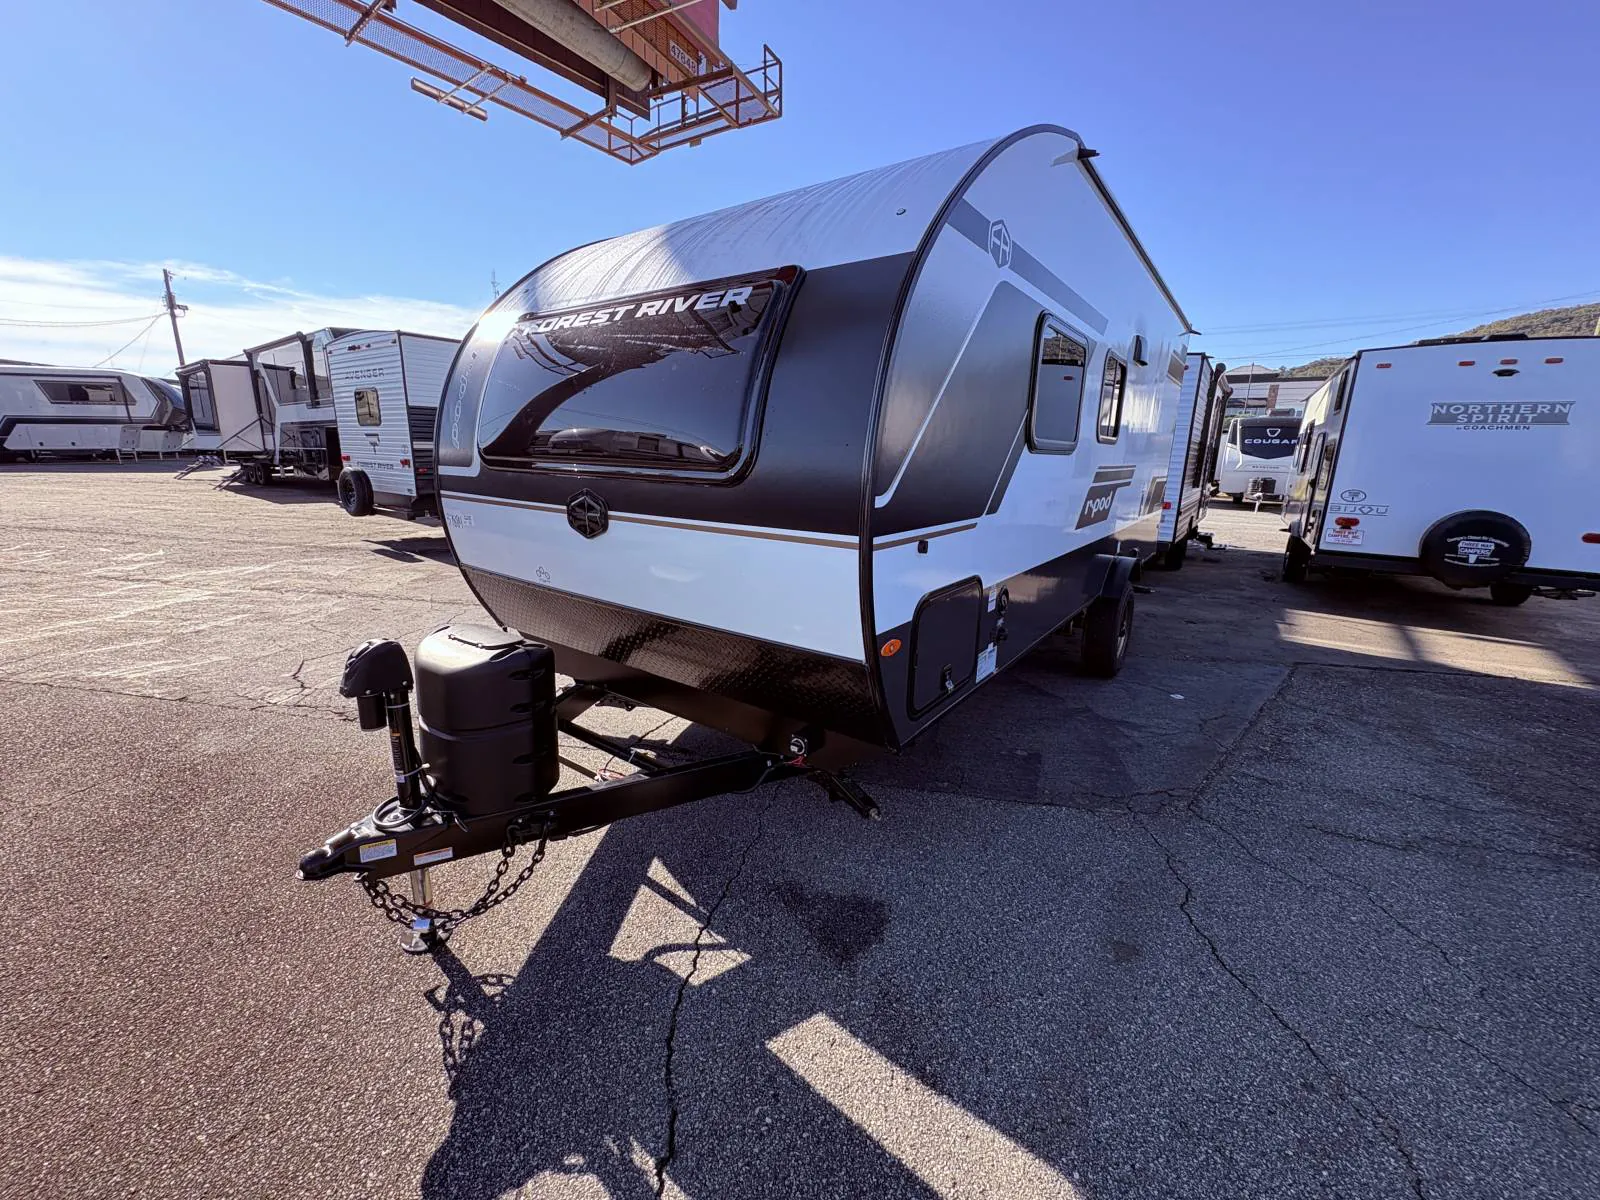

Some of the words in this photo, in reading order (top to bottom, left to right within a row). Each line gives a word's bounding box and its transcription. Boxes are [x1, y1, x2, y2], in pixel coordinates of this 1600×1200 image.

[636, 286, 753, 317] RIVER
[1432, 403, 1570, 414] NORTHERN
[1456, 413, 1538, 423] SPIRIT
